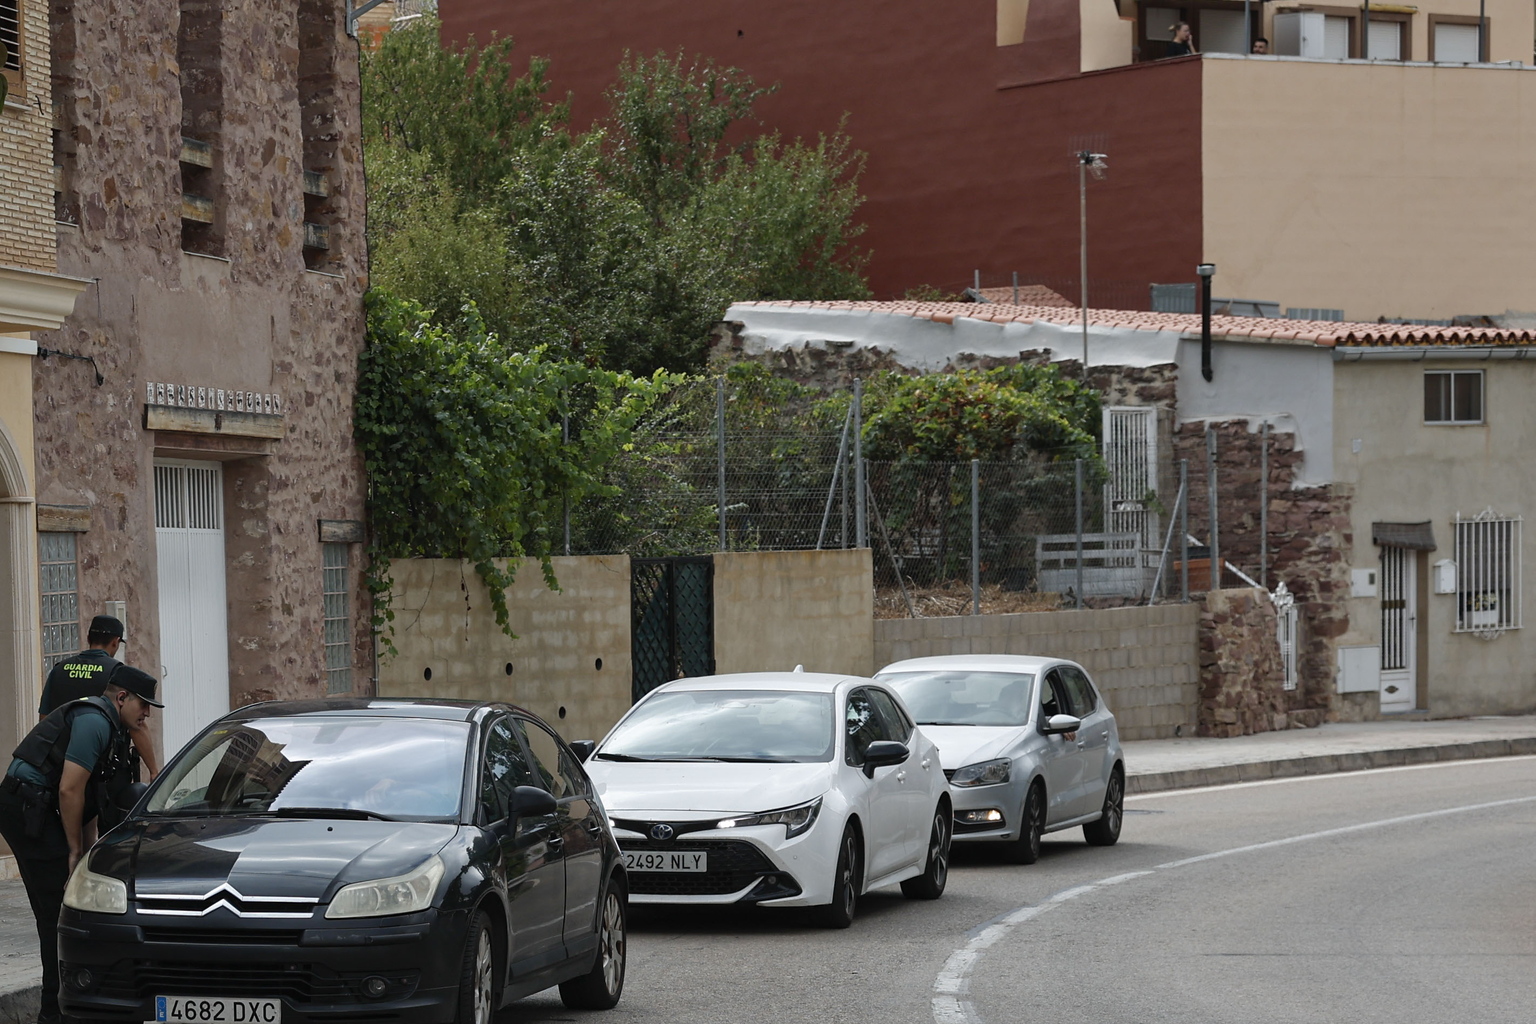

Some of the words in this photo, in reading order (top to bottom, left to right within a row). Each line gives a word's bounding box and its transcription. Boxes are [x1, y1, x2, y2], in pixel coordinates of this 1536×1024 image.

[64, 663, 103, 672] GUARDIA
[69, 670, 92, 679] CIVIL
[626, 855, 664, 869] 2492
[671, 855, 701, 869] NLY
[171, 1000, 225, 1021] 4682
[233, 1002, 275, 1022] DXC
